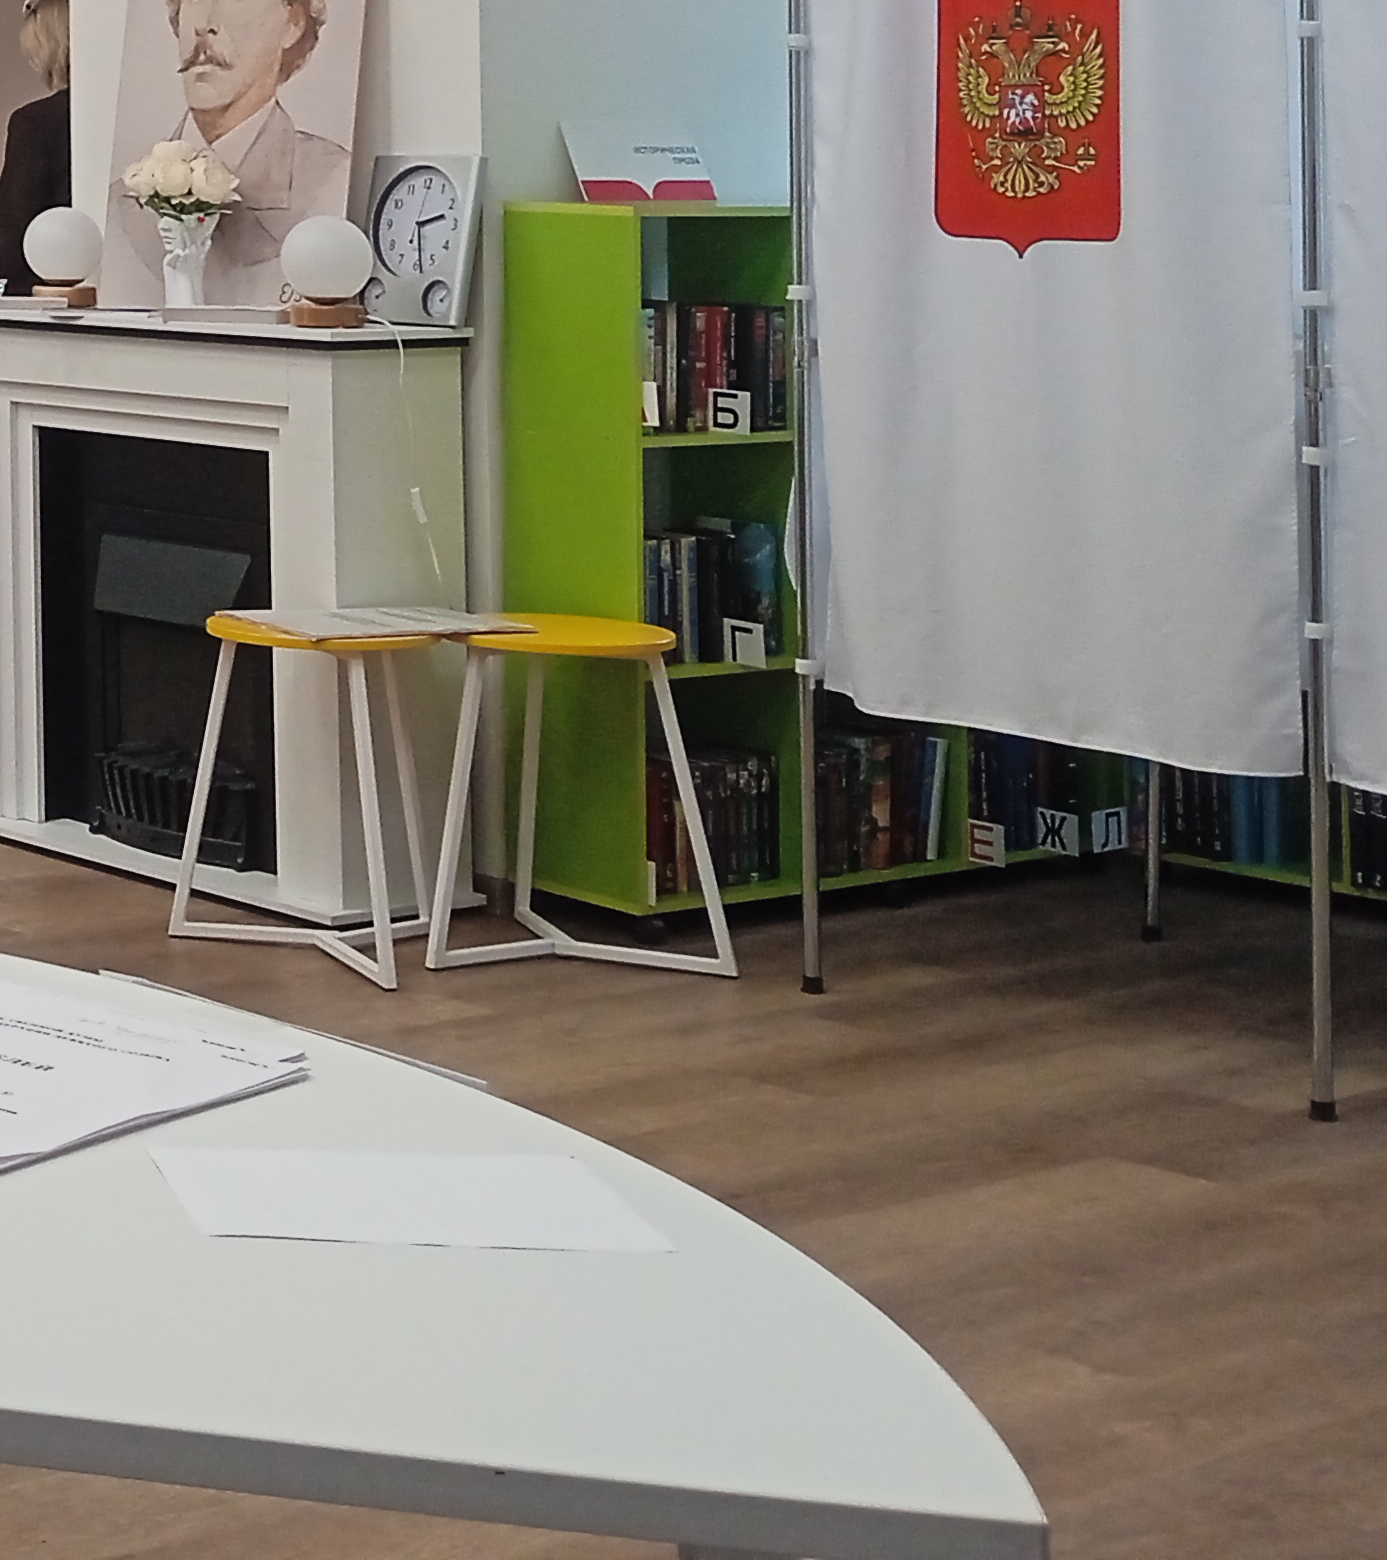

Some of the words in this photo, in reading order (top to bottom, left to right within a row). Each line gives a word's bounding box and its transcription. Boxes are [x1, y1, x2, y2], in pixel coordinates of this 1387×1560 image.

[407, 184, 415, 196] 11
[423, 177, 433, 190] 12
[441, 183, 446, 195] 1
[393, 198, 404, 210] 10
[448, 198, 455, 211] 2
[387, 219, 393, 231] 9
[451, 218, 458, 232] 3
[389, 239, 396, 252] 8
[442, 240, 450, 251] 4
[398, 254, 405, 265] 7
[412, 259, 420, 272] 6
[429, 254, 436, 267] 5
[713, 391, 740, 430] Б
[731, 624, 754, 663] Г
[1038, 810, 1068, 852] Ж
[1101, 810, 1123, 852] Л
[969, 822, 995, 863] Е
